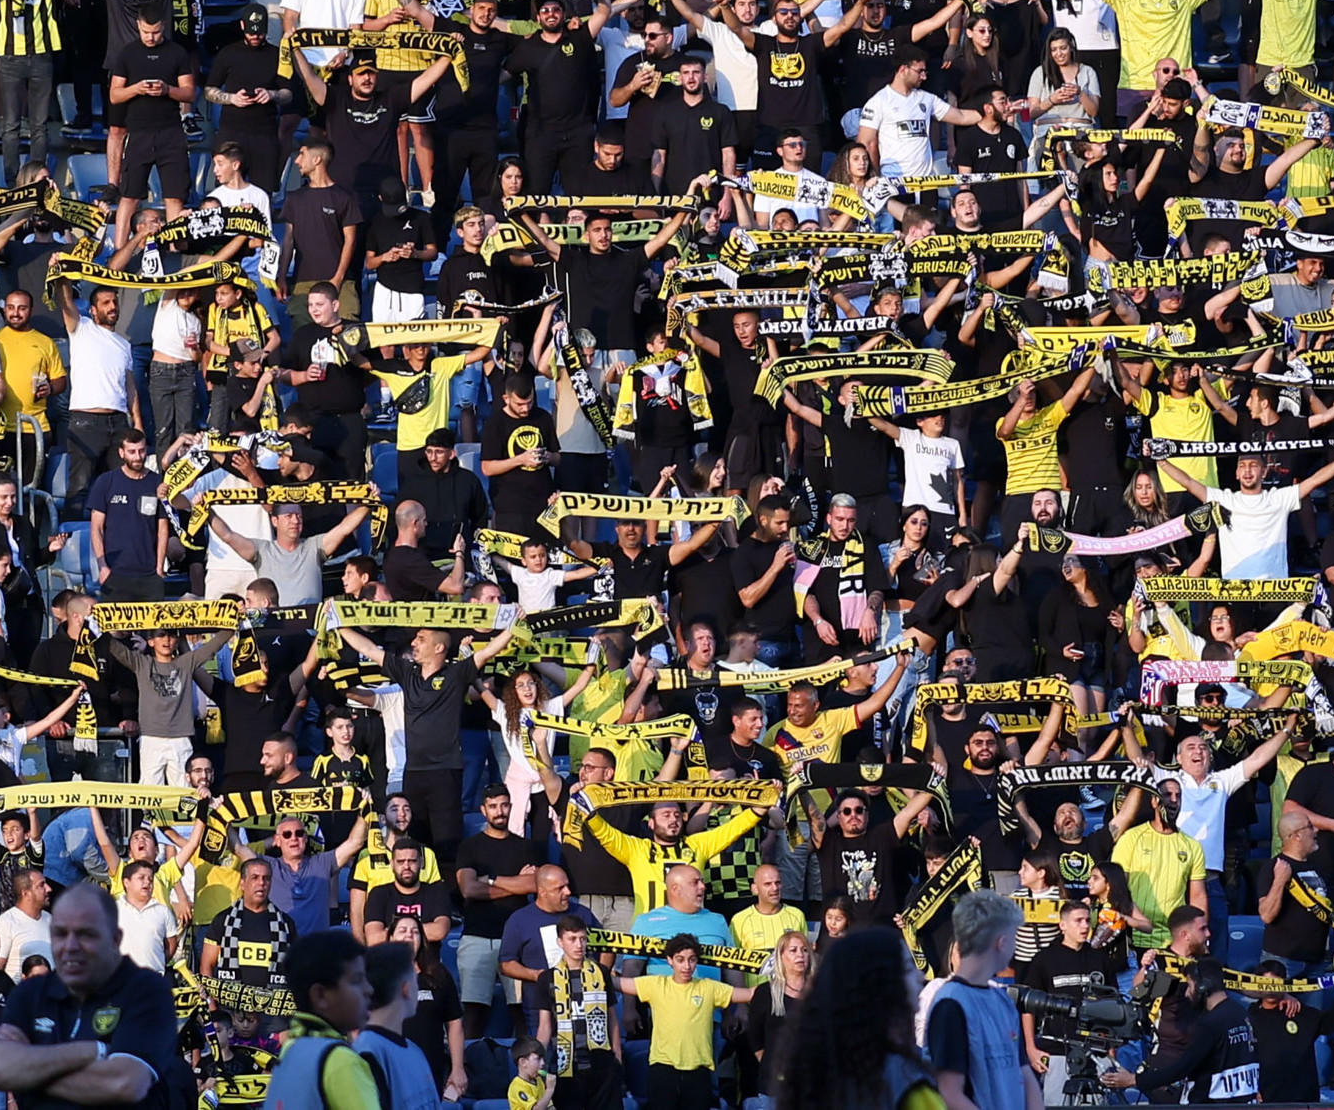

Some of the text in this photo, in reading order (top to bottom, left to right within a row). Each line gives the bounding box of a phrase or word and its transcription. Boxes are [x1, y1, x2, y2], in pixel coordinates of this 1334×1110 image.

[1180, 439, 1324, 455] READY TO FIGHT
[564, 493, 725, 517] בית"ר ירושלים
[785, 744, 831, 762] Rakuten
[59, 793, 81, 804] אני
[129, 794, 163, 808] אוהב
